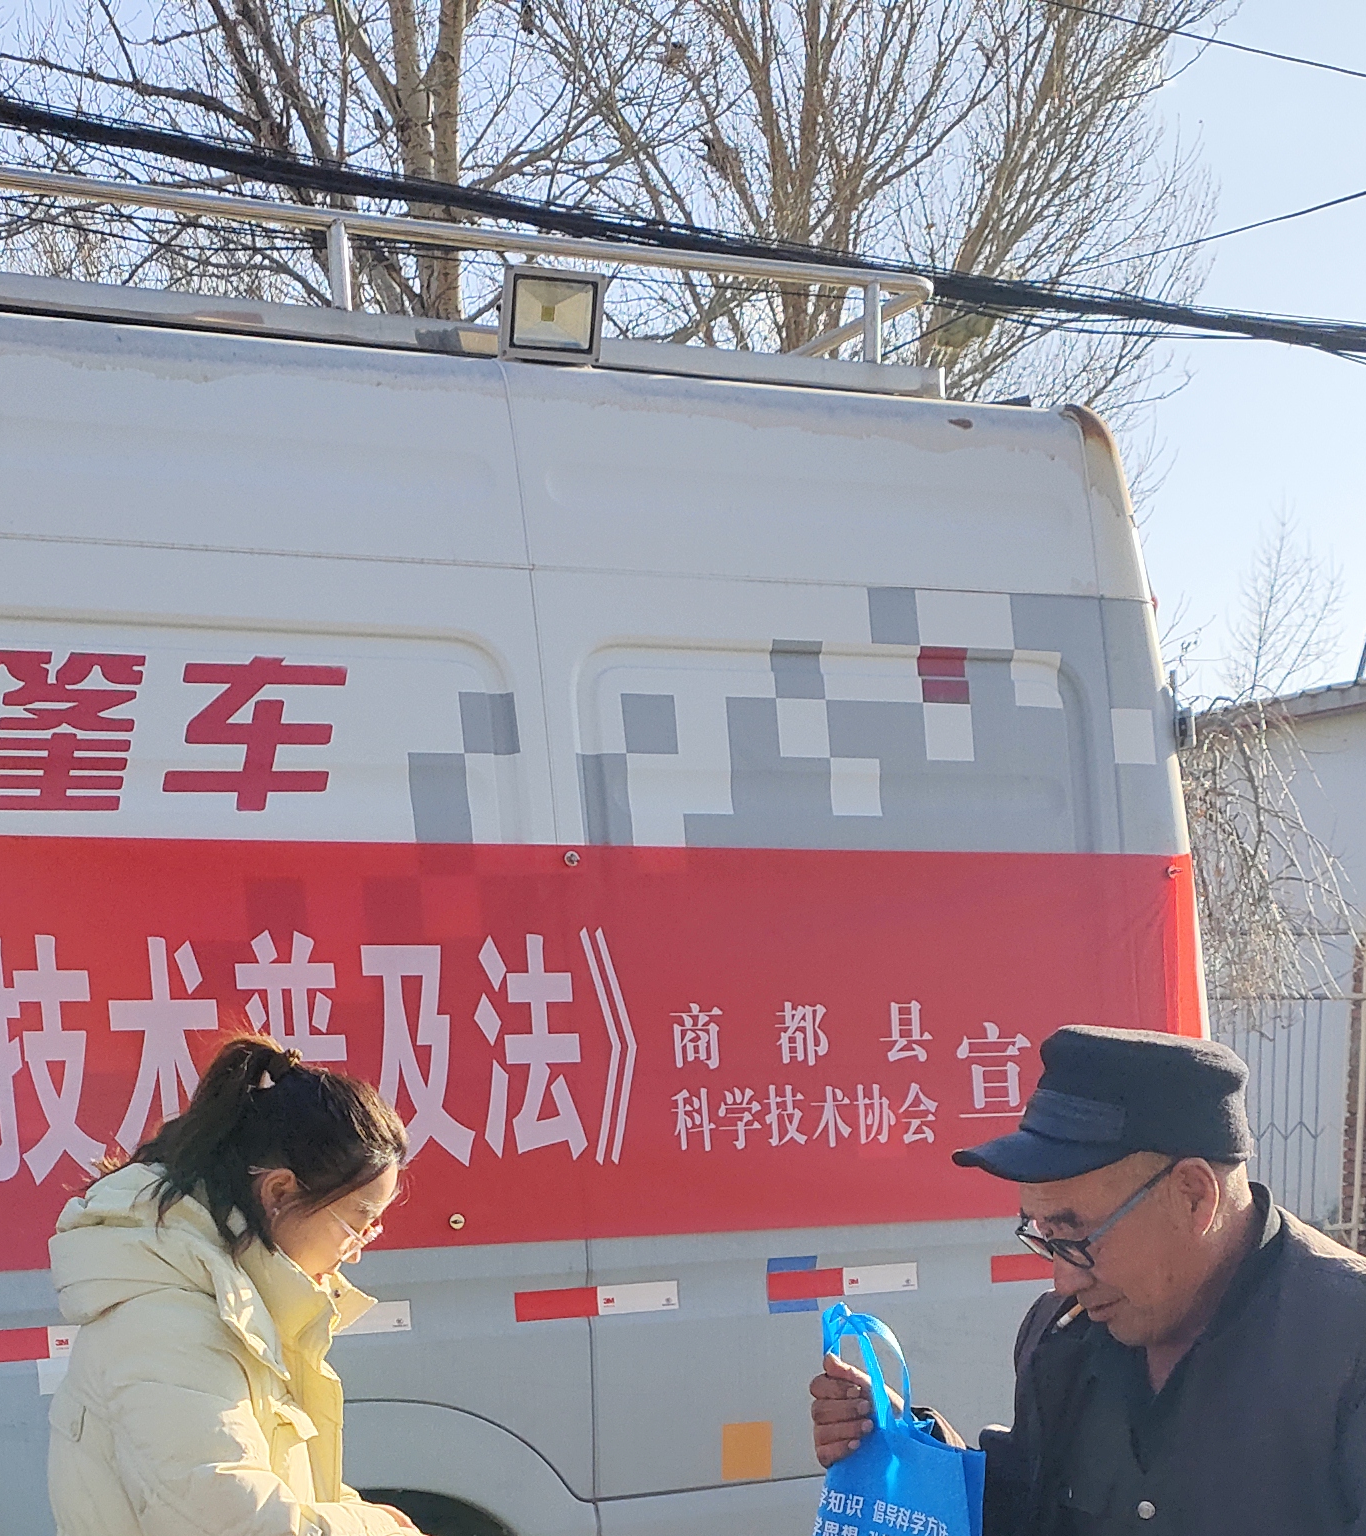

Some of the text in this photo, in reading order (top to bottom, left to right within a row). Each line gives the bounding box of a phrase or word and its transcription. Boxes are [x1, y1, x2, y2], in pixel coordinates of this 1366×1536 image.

[669, 1000, 934, 1070] 商都县
[956, 1022, 1032, 1118] 宣
[671, 1083, 939, 1152] 科学技术协会
